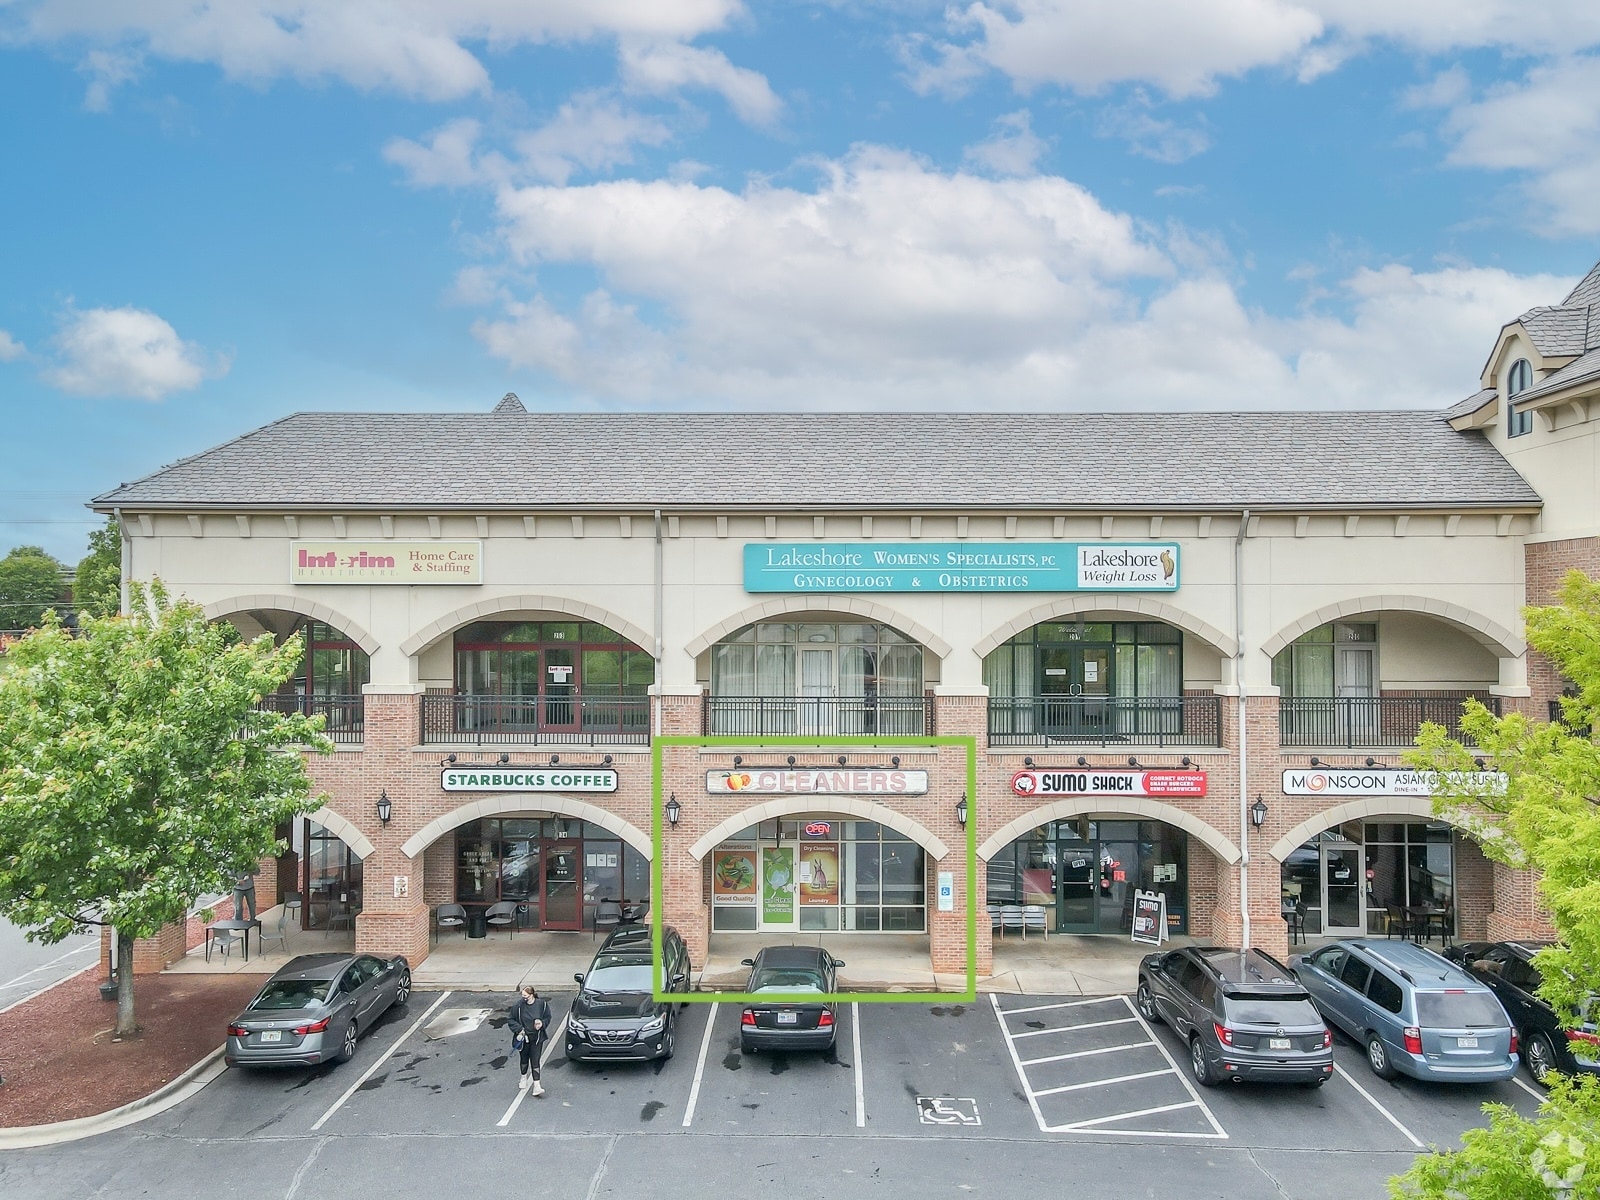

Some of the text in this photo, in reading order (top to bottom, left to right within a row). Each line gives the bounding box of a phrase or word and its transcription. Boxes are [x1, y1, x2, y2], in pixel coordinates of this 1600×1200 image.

[409, 551, 474, 561] Home Care
[767, 548, 1056, 567] Lakeshore WOMEN'S SPECIALISTS, PC
[1082, 550, 1157, 567] Lakeshore
[412, 562, 471, 574] & Staffing
[793, 573, 1029, 587] GYNECOLOGY & OBSTETRICS
[1083, 570, 1157, 583] Weight Loss
[447, 774, 612, 786] STARBUCKS COFFEE
[758, 771, 907, 791] CLEANERS
[1042, 773, 1133, 792] SUMO SHACK
[1291, 773, 1386, 791] MONSOON
[1394, 774, 1425, 785] ASIAN
[805, 824, 830, 834] OPEN
[1138, 900, 1159, 911] SUMO
